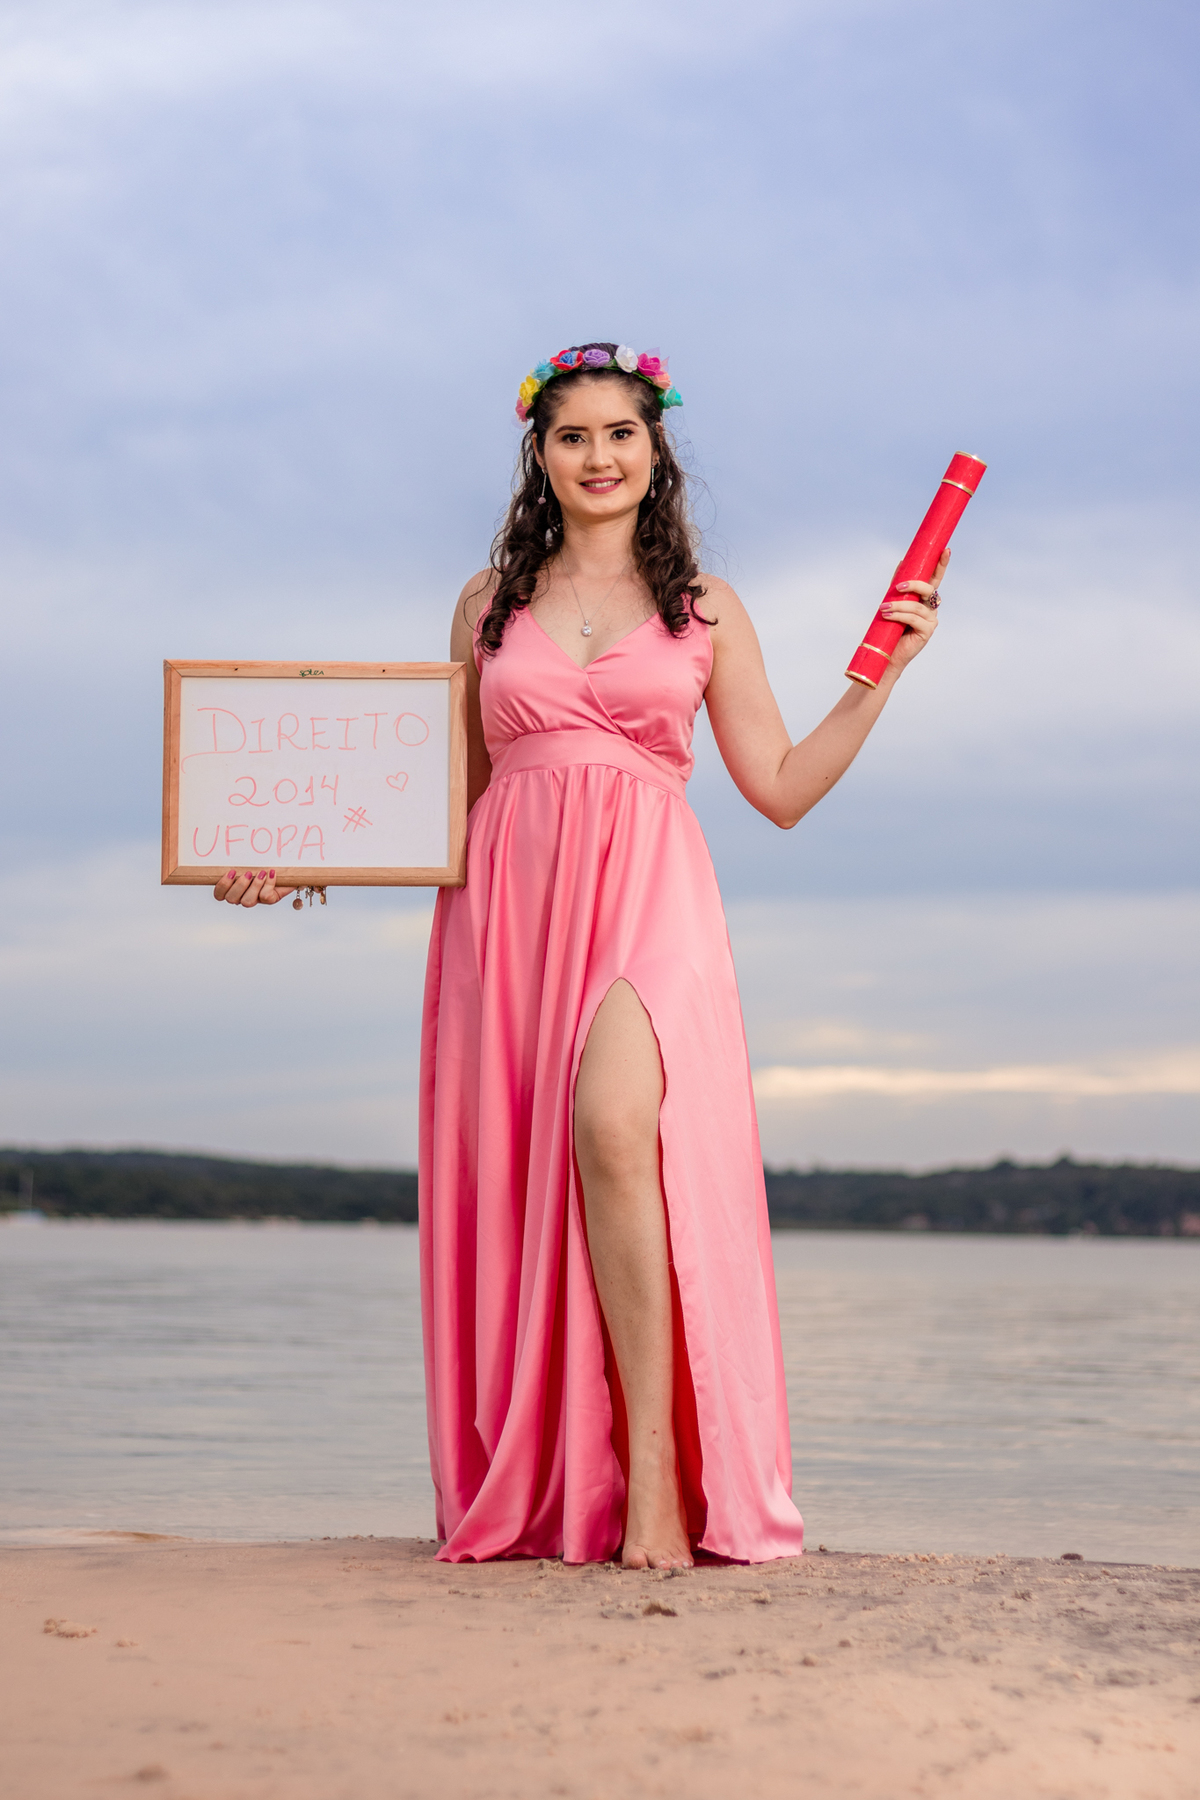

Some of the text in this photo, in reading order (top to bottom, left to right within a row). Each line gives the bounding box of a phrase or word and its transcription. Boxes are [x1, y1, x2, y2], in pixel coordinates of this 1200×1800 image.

[181, 707, 429, 774] DIREITO
[228, 775, 339, 807] 2014
[193, 825, 325, 861] UFOPA
